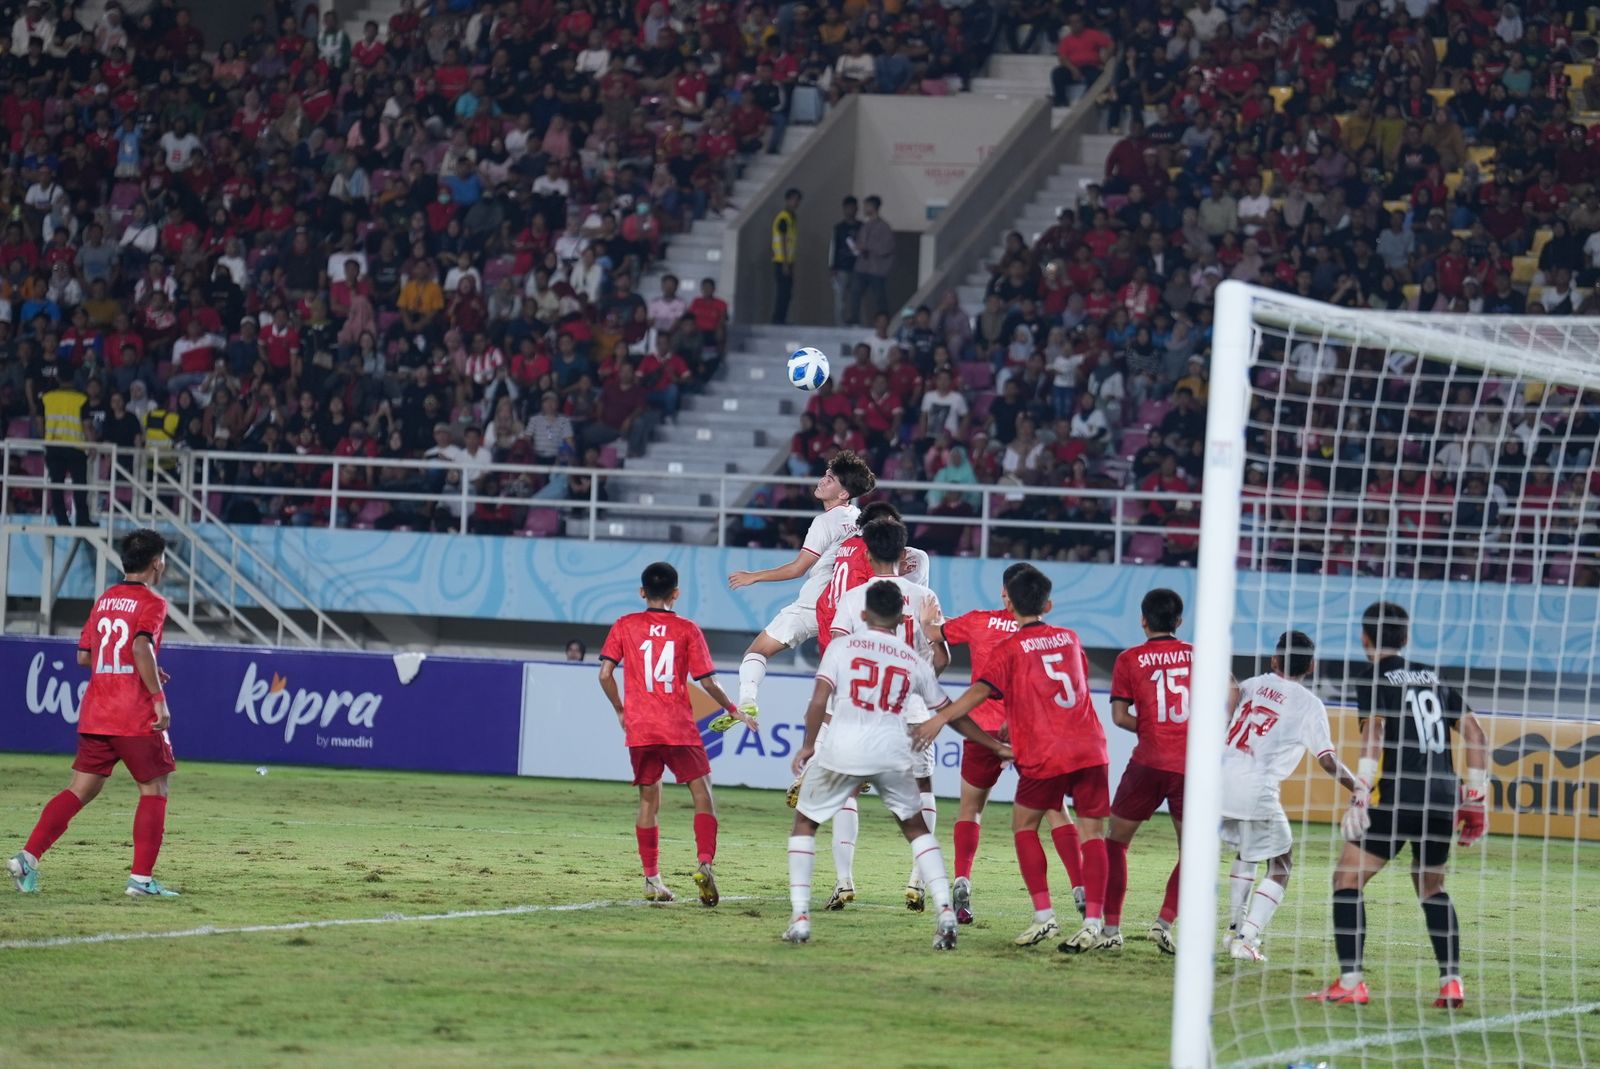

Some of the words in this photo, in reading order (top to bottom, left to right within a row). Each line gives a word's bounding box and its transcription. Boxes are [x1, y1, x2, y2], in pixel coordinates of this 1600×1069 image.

[96, 617, 134, 674] 22
[649, 624, 667, 637] KI
[846, 639, 875, 650] JOSH
[987, 616, 1020, 633] PHIS
[639, 639, 676, 694] 14
[850, 656, 911, 715] 20
[1041, 653, 1077, 709] 5
[234, 661, 383, 744] kopra
[1150, 666, 1191, 724] 15
[1405, 688, 1446, 754] 18
[316, 733, 330, 749] by
[330, 735, 373, 748] mandiri
[1225, 699, 1280, 757] 12
[1489, 763, 1600, 818] ndiri
